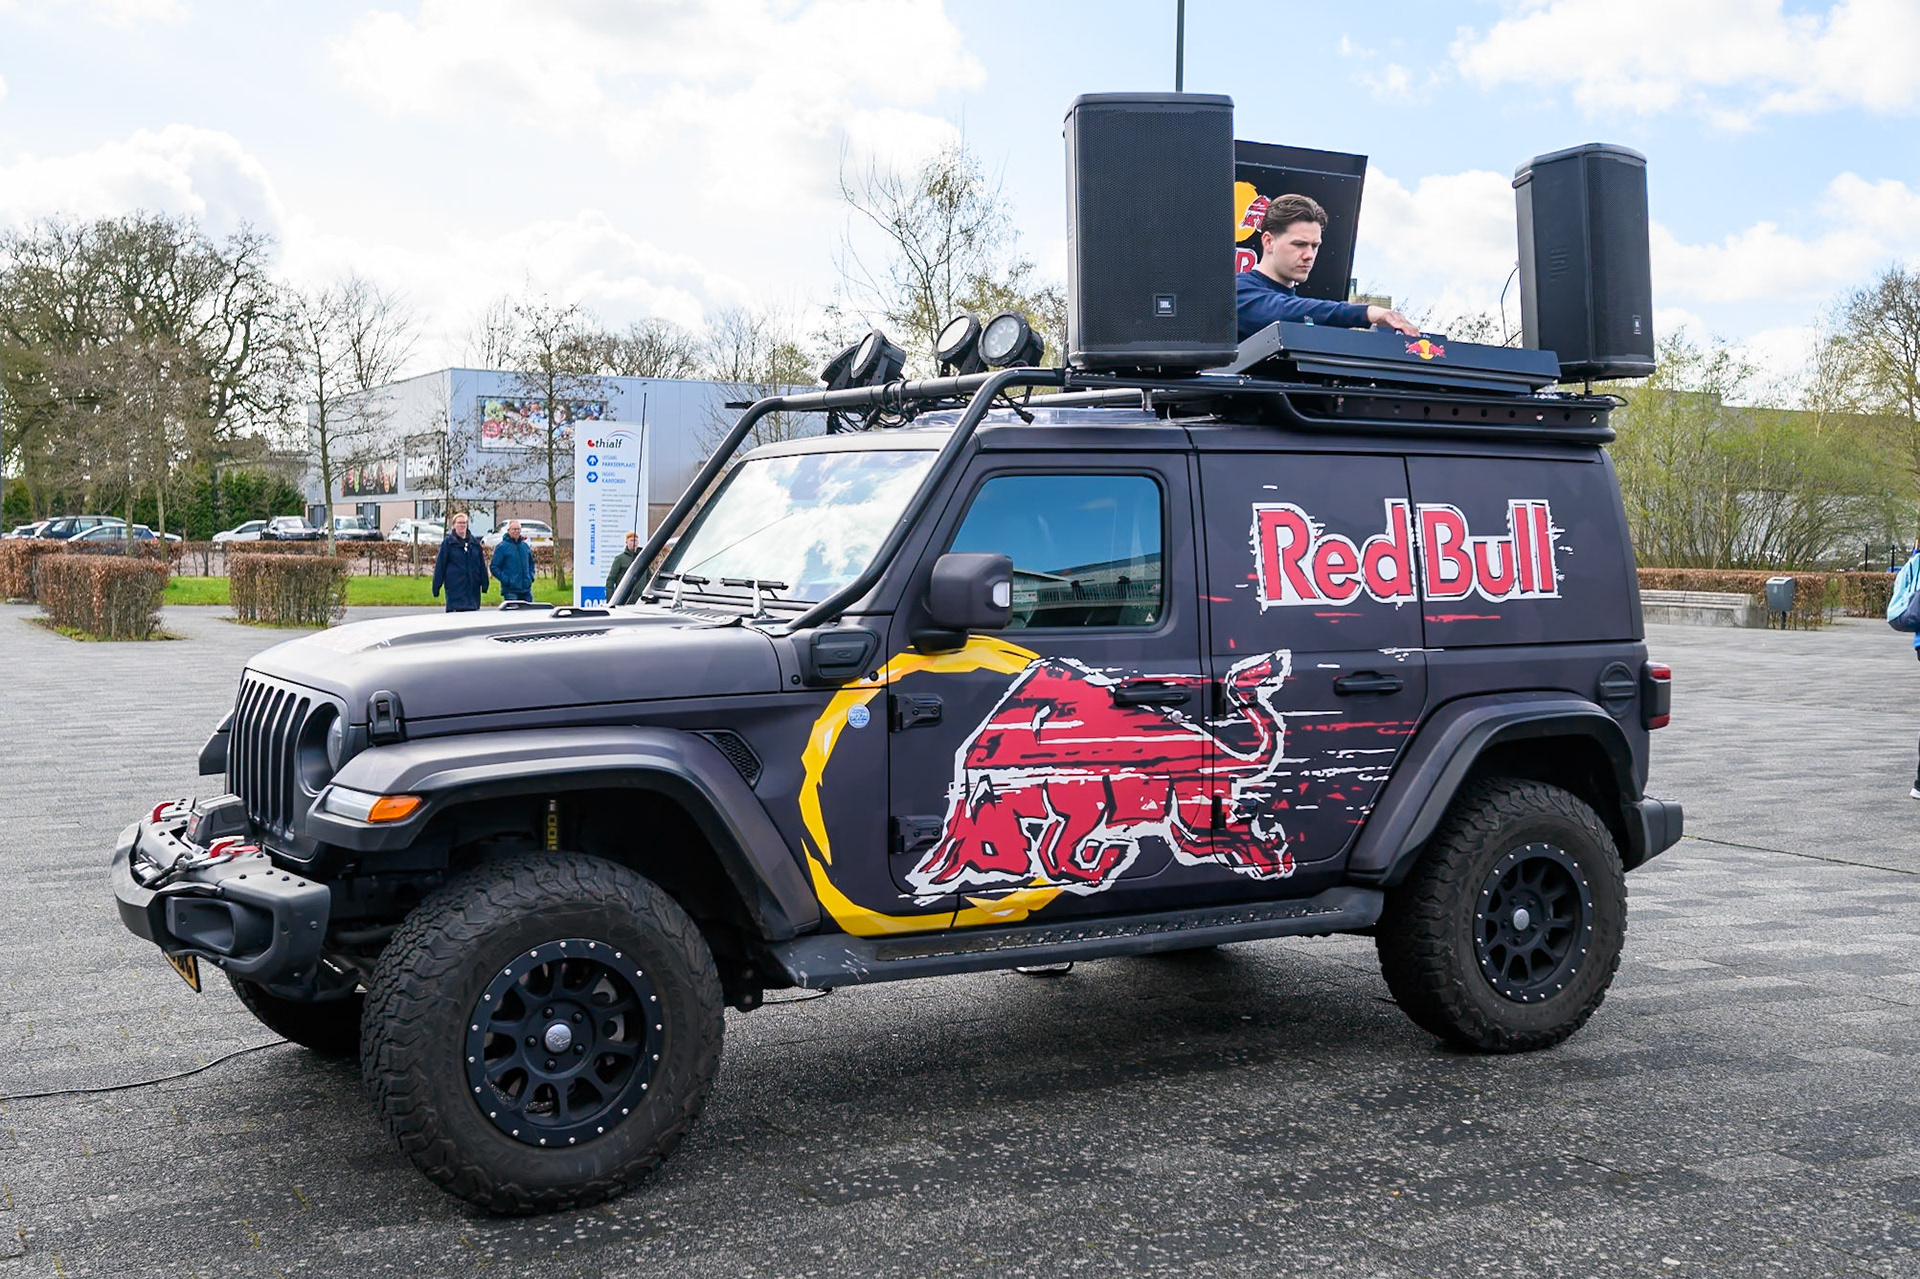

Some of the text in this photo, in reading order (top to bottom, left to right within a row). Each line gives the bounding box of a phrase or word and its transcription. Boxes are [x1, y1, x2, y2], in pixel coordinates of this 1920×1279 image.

[595, 438, 622, 448] thialf
[1254, 500, 1558, 604] Red Bull
